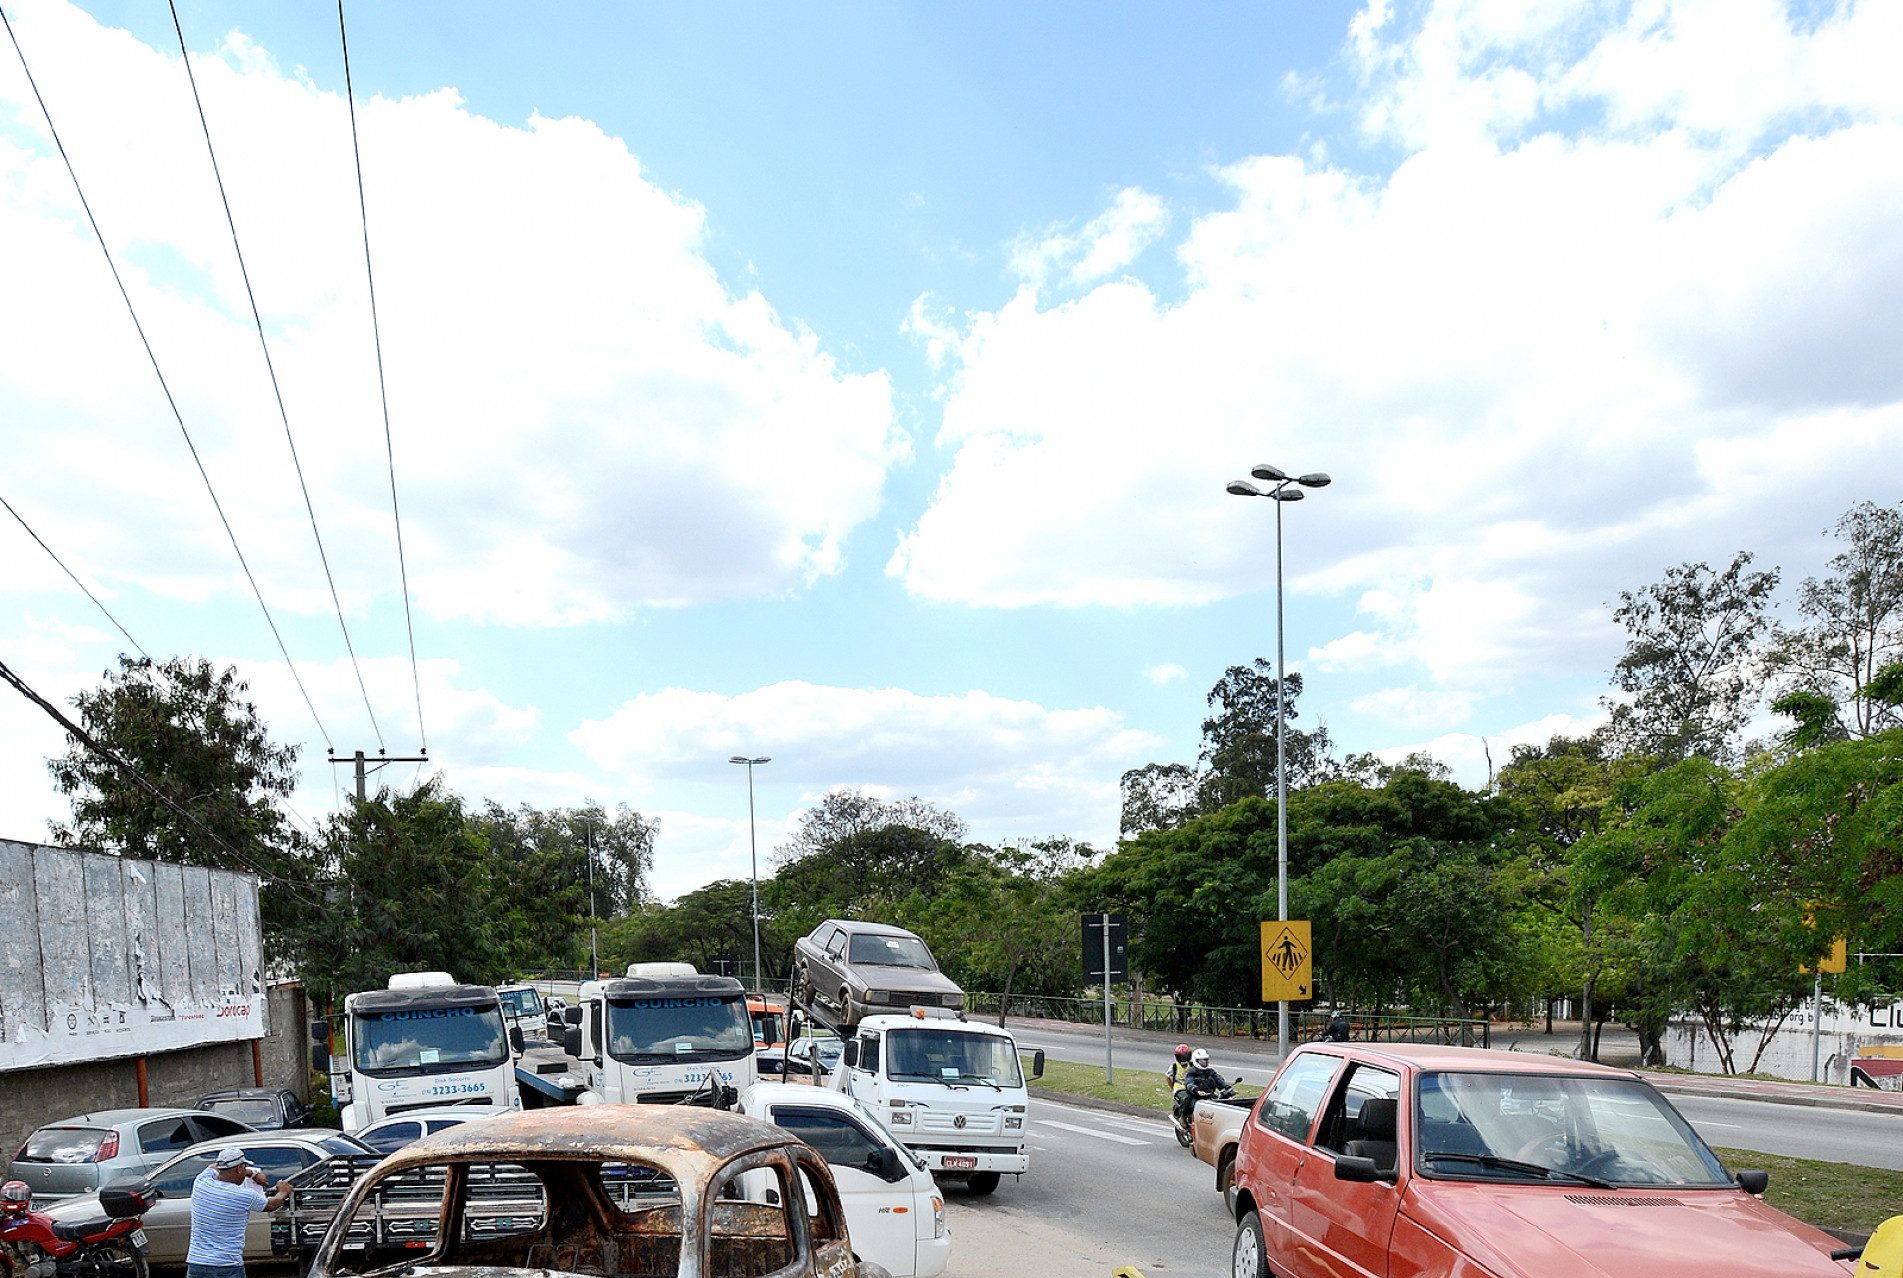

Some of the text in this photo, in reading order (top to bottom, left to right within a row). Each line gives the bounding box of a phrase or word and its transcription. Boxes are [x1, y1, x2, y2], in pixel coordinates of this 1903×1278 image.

[634, 998, 723, 1009] GUINCHO
[380, 1007, 475, 1022] GUINCHO
[432, 1082, 486, 1096] 3233-3665
